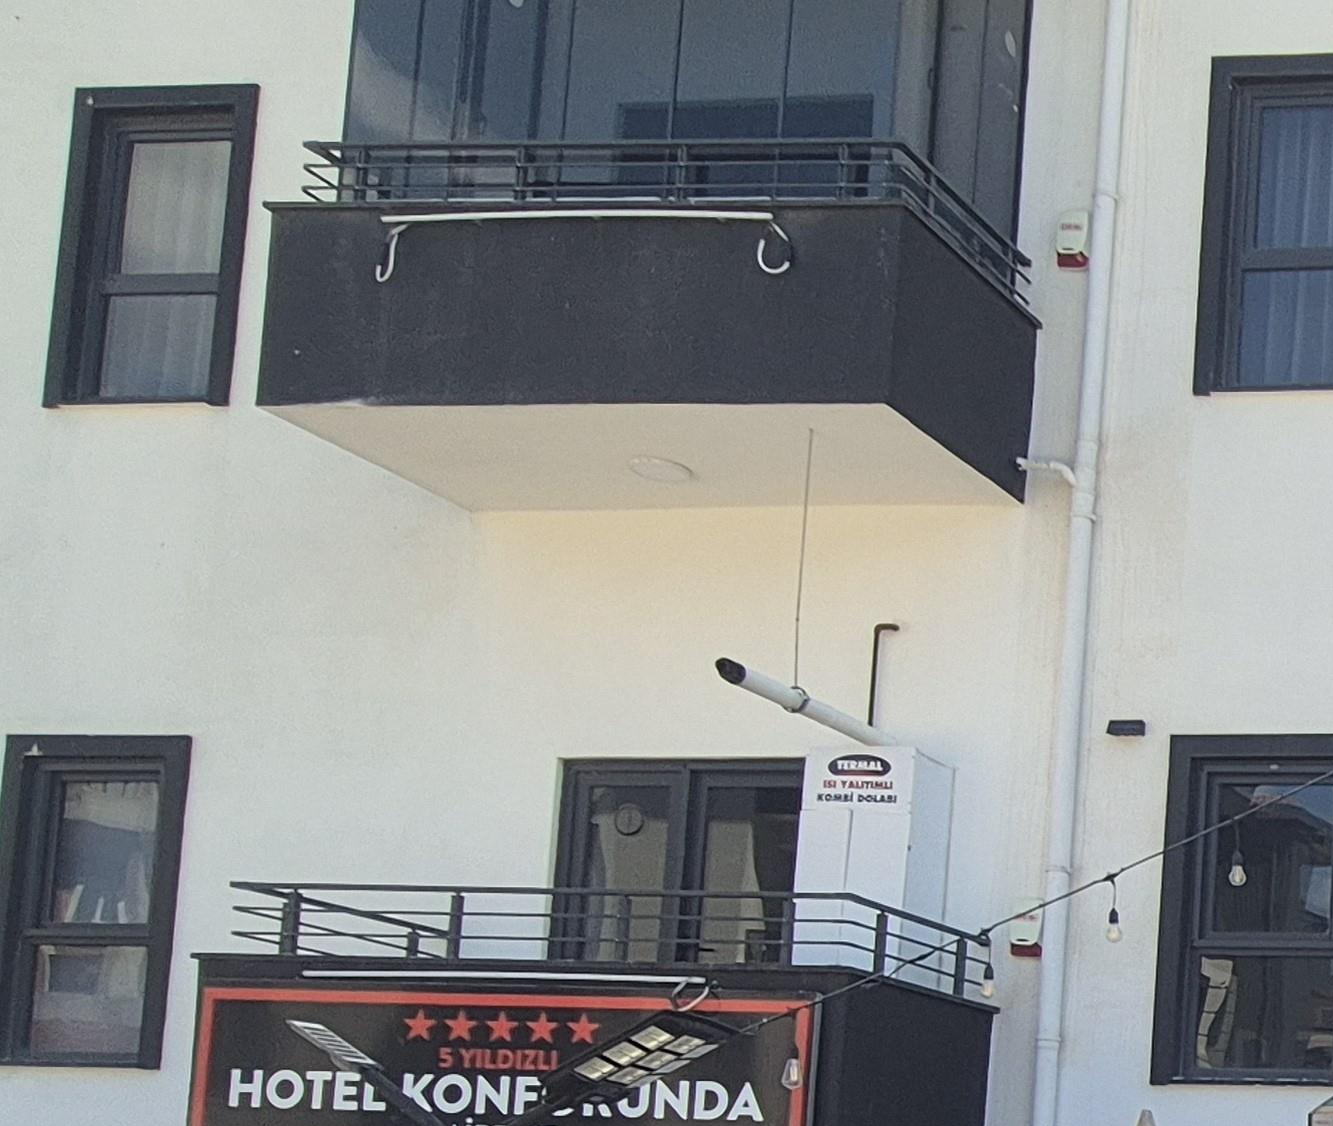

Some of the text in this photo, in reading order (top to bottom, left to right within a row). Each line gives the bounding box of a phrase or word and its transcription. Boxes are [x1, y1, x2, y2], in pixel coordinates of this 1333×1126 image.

[438, 1048, 559, 1072] 5 YILDIZLI
[229, 1069, 764, 1122] HOTEL KONFUNDA
